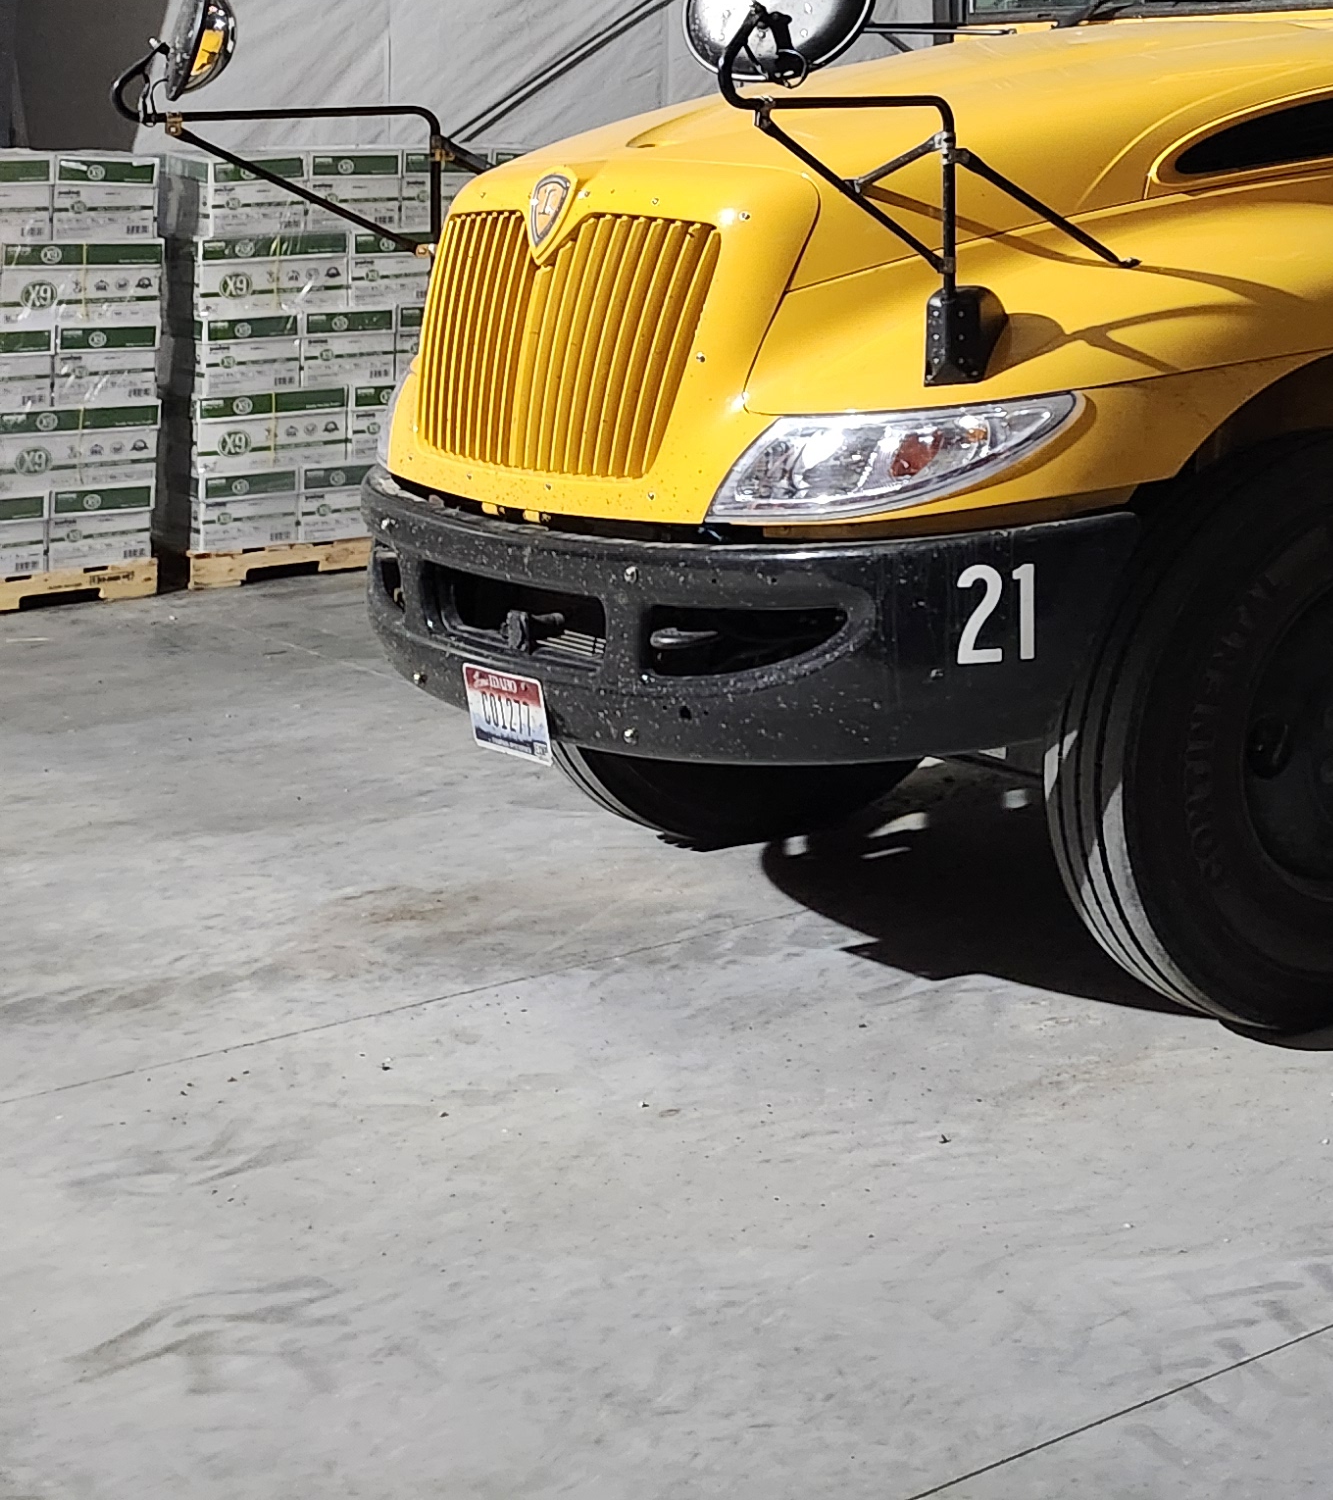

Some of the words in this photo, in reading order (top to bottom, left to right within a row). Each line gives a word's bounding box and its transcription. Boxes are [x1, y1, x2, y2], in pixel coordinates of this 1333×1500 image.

[28, 284, 52, 307] X9
[227, 275, 250, 295] X9
[224, 434, 247, 455] X9
[22, 450, 48, 472] X9
[957, 563, 1035, 665] 21
[488, 674, 518, 694] IDAHO
